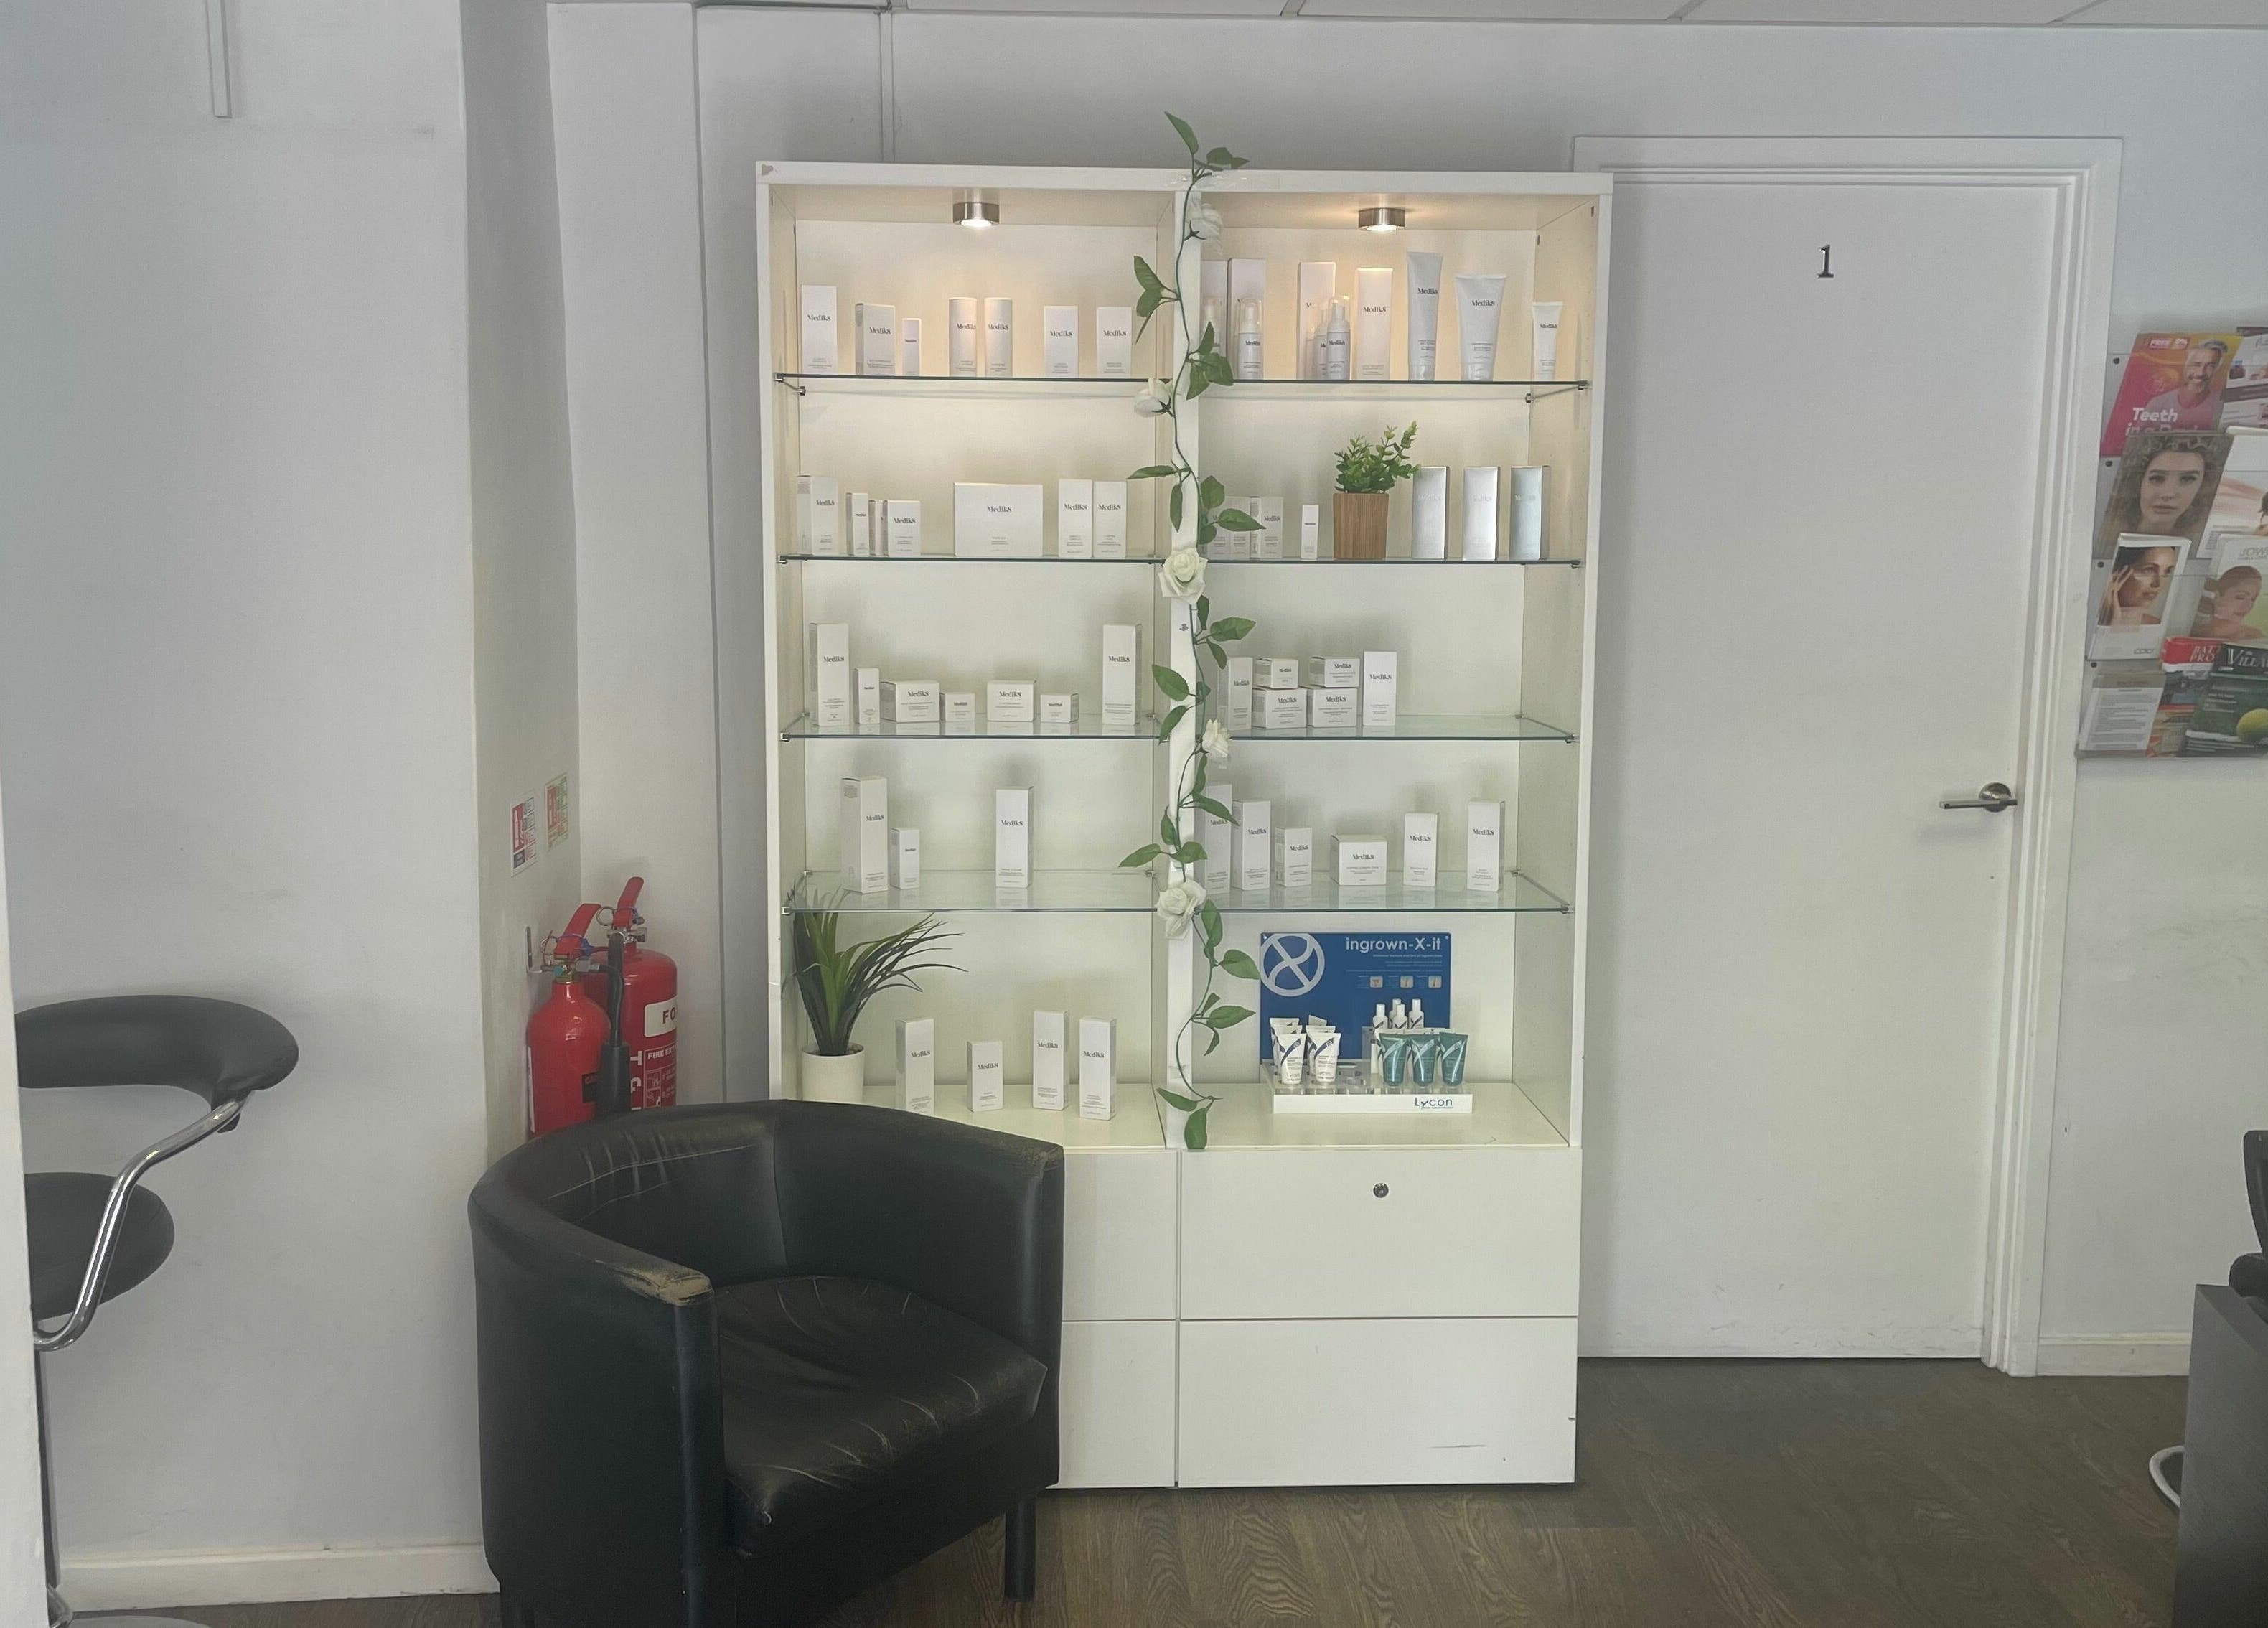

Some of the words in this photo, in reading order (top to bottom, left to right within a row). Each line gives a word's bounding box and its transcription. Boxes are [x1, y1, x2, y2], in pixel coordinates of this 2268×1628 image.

[1818, 243, 1834, 279] 1
[2132, 407, 2178, 423] Teeth
[1345, 937, 1442, 954] ingrown-X-it
[647, 1049, 665, 1061] FIRE
